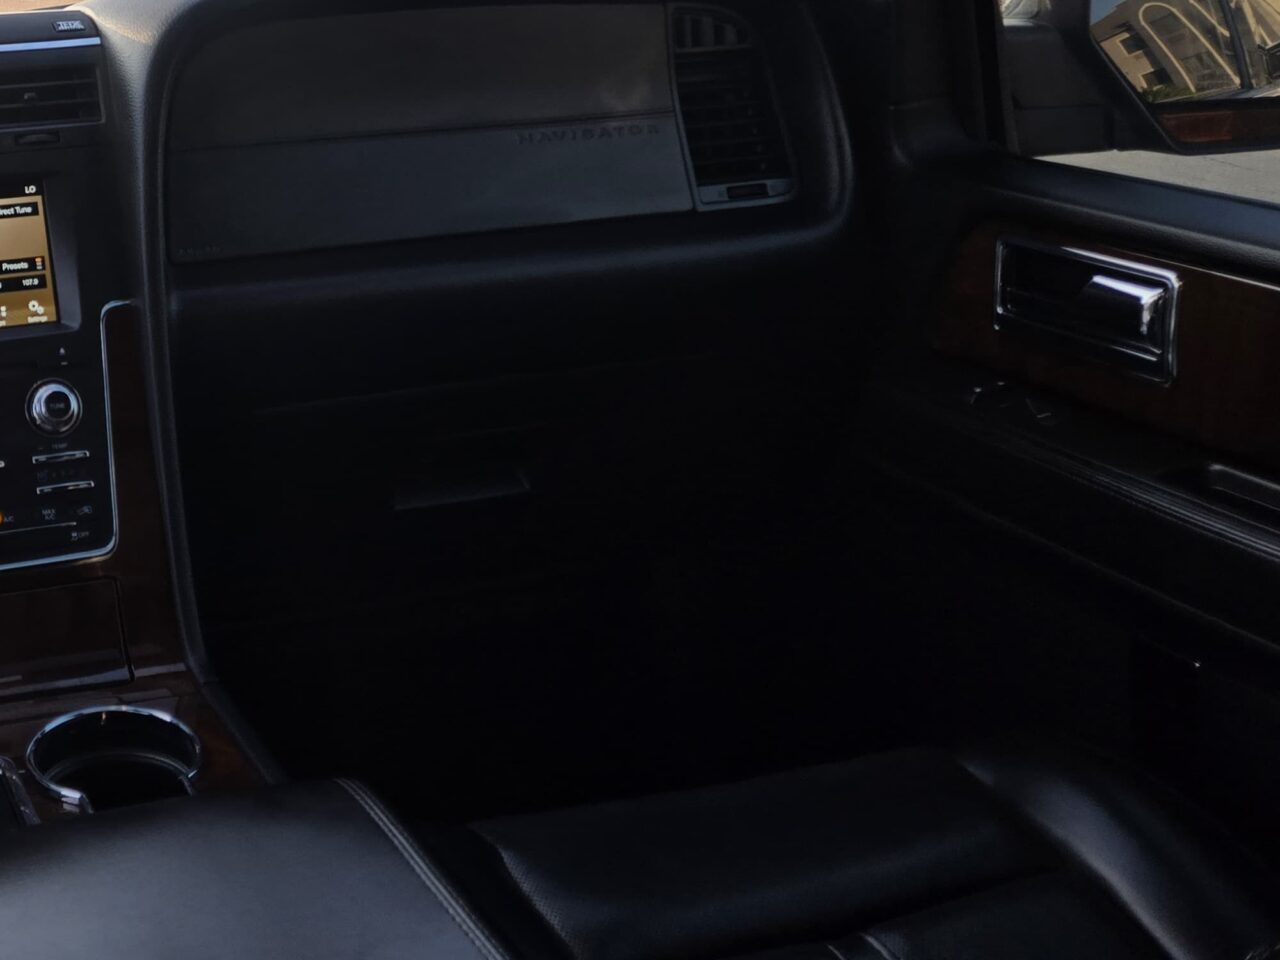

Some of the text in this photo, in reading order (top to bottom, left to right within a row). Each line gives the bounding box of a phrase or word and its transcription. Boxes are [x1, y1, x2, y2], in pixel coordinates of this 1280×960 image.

[24, 185, 36, 194] LO
[15, 206, 32, 214] Tune
[2, 262, 29, 271] Presets
